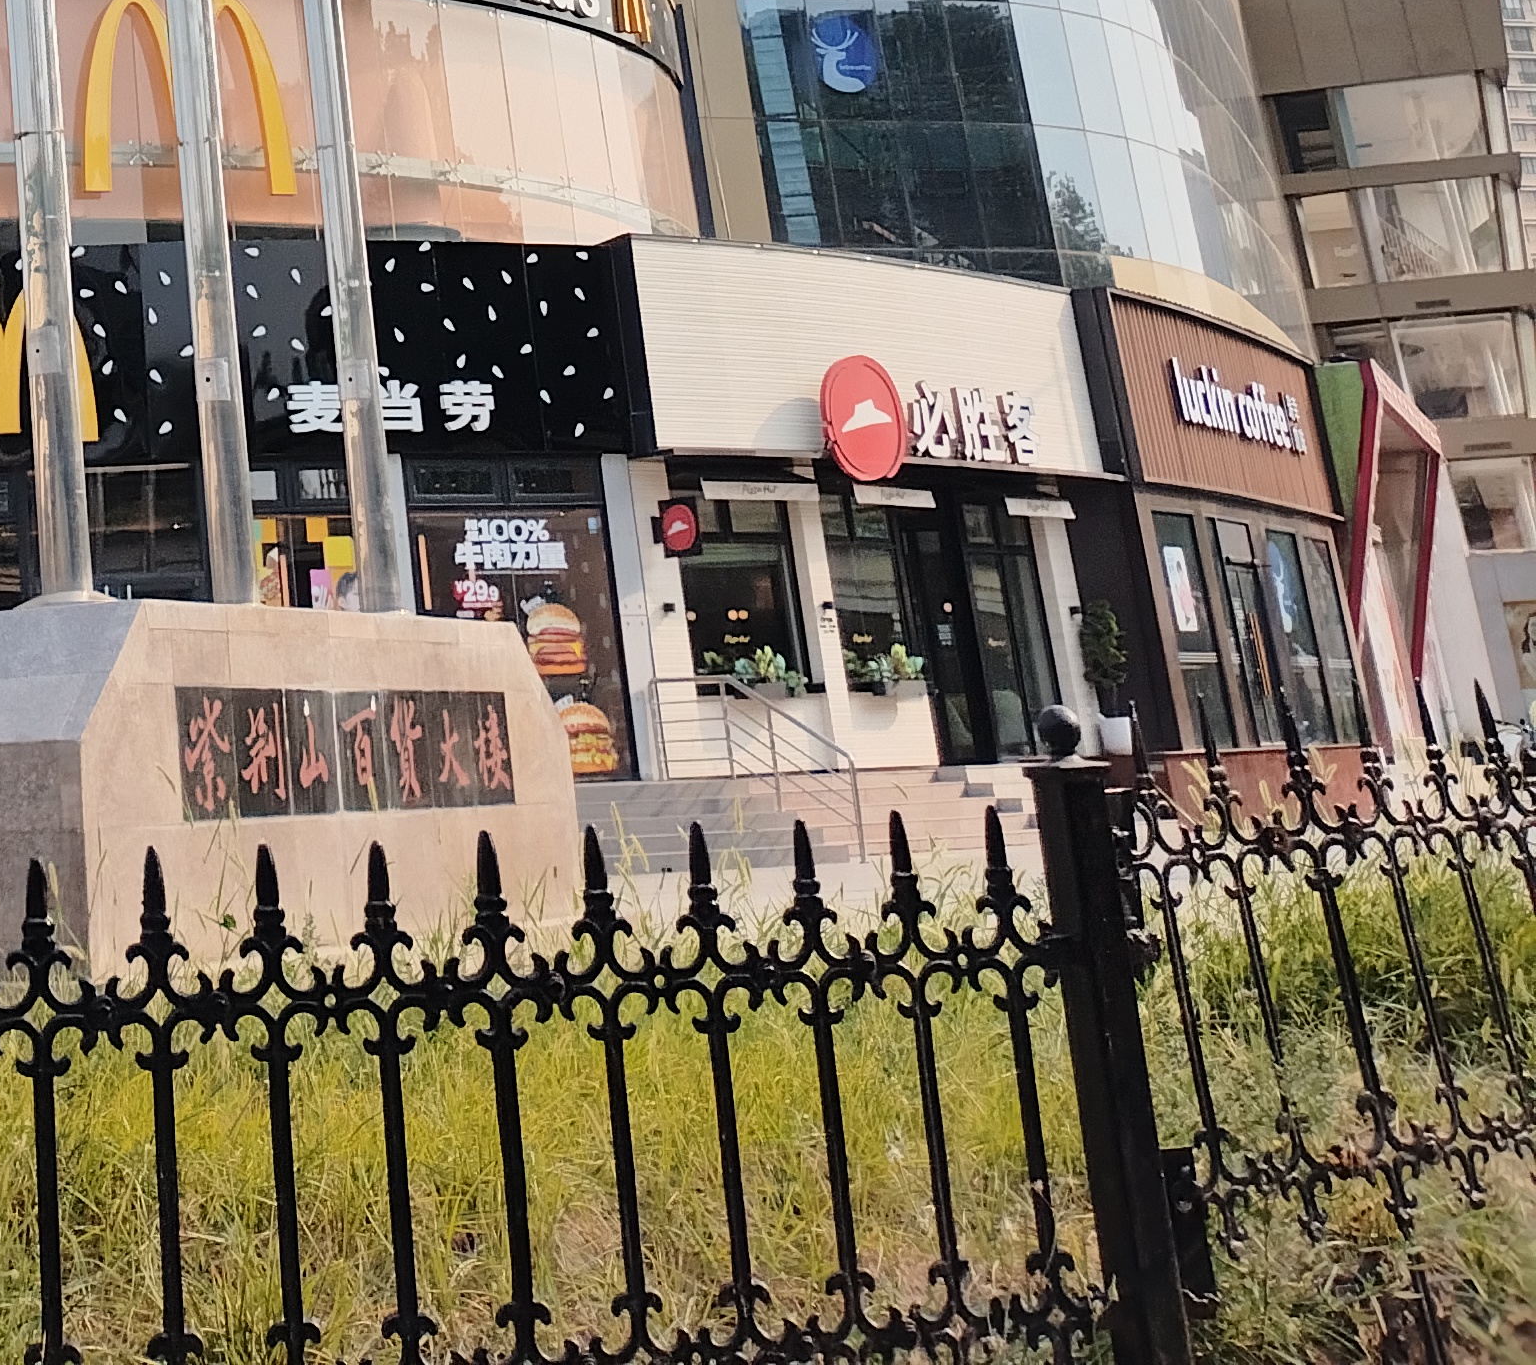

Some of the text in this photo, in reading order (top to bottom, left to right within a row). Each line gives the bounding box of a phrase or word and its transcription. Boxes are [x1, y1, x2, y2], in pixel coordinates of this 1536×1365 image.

[286, 380, 496, 433] 麦当劳
[909, 380, 1041, 464] 必胜客
[1170, 356, 1241, 435] luckin
